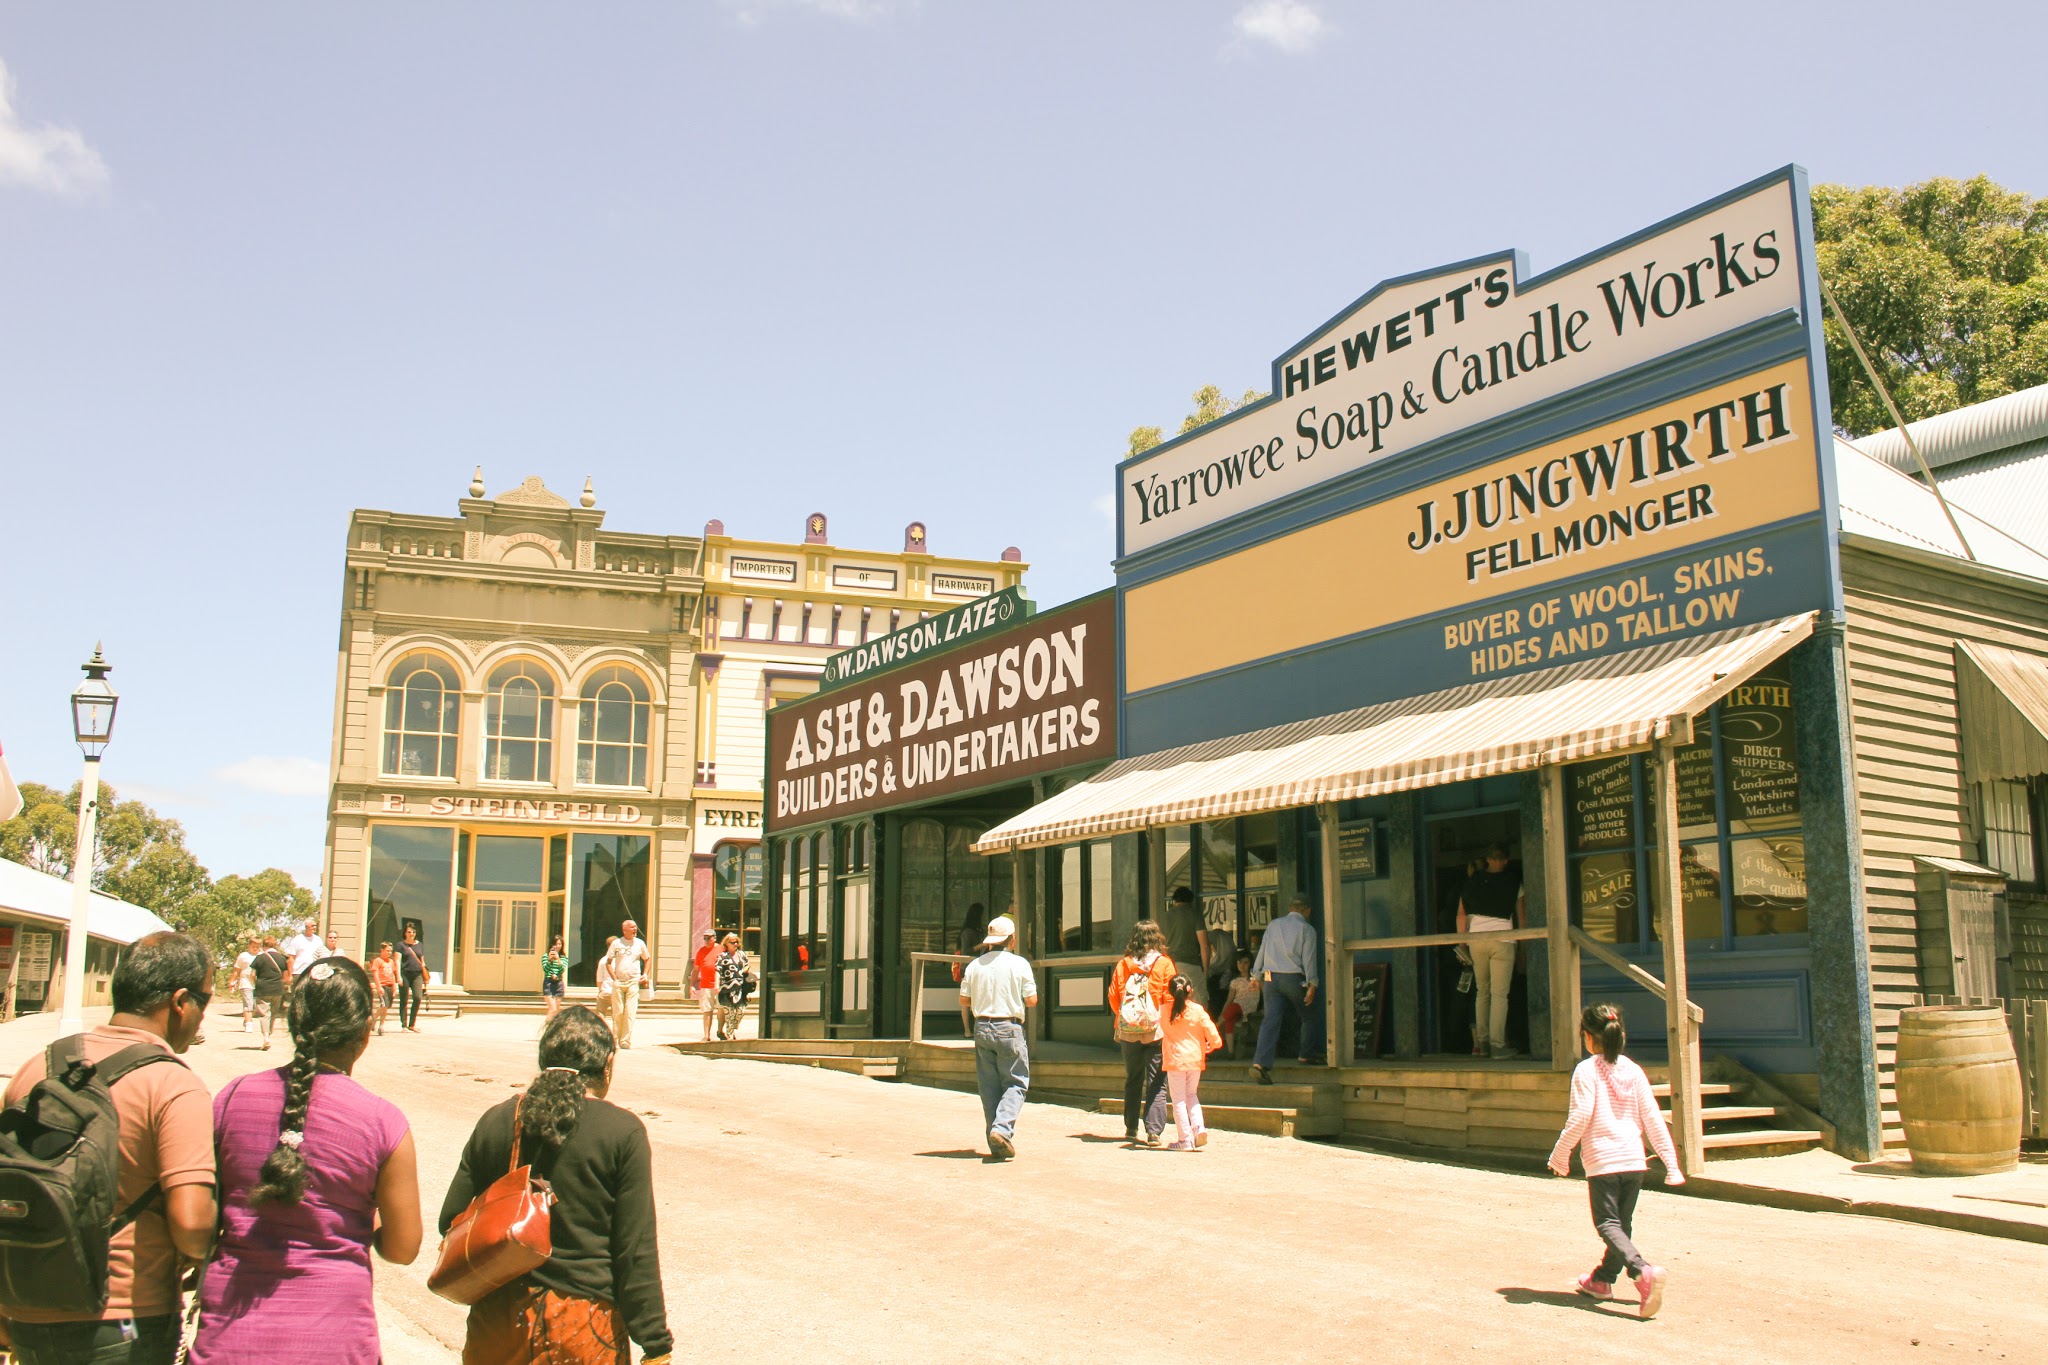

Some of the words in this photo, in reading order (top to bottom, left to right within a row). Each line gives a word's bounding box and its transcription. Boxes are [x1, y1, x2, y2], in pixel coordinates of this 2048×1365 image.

[1285, 268, 1510, 398] HEWETT'S
[1132, 436, 1284, 525] Yarrowee
[1296, 392, 1394, 462] Soap
[1401, 380, 1428, 420] &
[1431, 303, 1592, 405] Candle
[1597, 229, 1780, 337] Works
[1466, 483, 1716, 583] FELLMONGER
[735, 562, 792, 576] IMPORTERS
[859, 572, 871, 583] OF
[937, 579, 989, 593] HARDWARE
[1444, 609, 1520, 650] BUYER
[1528, 598, 1561, 629] OF
[1570, 576, 1665, 619] WOOL,
[1673, 547, 1774, 594] SKINS,
[944, 596, 1000, 641] LATE
[1471, 636, 1542, 675] HIDES
[1548, 621, 1609, 659] AND
[1616, 588, 1741, 643] TALLOW
[785, 698, 862, 771] ASH
[866, 691, 892, 748] &
[900, 623, 1087, 739] DAWSON
[1726, 686, 1791, 708] IRTH
[777, 758, 878, 818] BUILDERS
[882, 759, 898, 795] &
[902, 698, 1100, 788] UNDERTAKERS
[1743, 745, 1782, 758] DIRECT
[1587, 755, 1630, 784] prepared
[1731, 756, 1795, 771] SHIPPERS
[1593, 785, 1603, 795] to
[1606, 773, 1630, 790] make
[1683, 776, 1699, 787] and
[1701, 775, 1711, 784] of
[1733, 777, 1775, 791] London
[1777, 773, 1798, 785] and
[1739, 790, 1795, 803] Yorkshire
[381, 793, 411, 814] E.
[429, 796, 643, 824] STEINFELD
[1583, 814, 1595, 823] ON
[1597, 808, 1627, 821] WOOL
[1746, 802, 1793, 816] Markets
[704, 809, 763, 828] EYRE
[1584, 823, 1597, 831] AND
[1599, 820, 1625, 830] OTHER
[1677, 812, 1714, 824] ednesday
[1584, 828, 1628, 842] PRODUCE
[1741, 856, 1752, 869] of
[1756, 858, 1773, 874] the
[1582, 889, 1598, 903] ON
[1601, 874, 1632, 898] SALE
[1690, 877, 1714, 887] Twine
[1742, 875, 1766, 888] best
[1695, 888, 1715, 898] Wire
